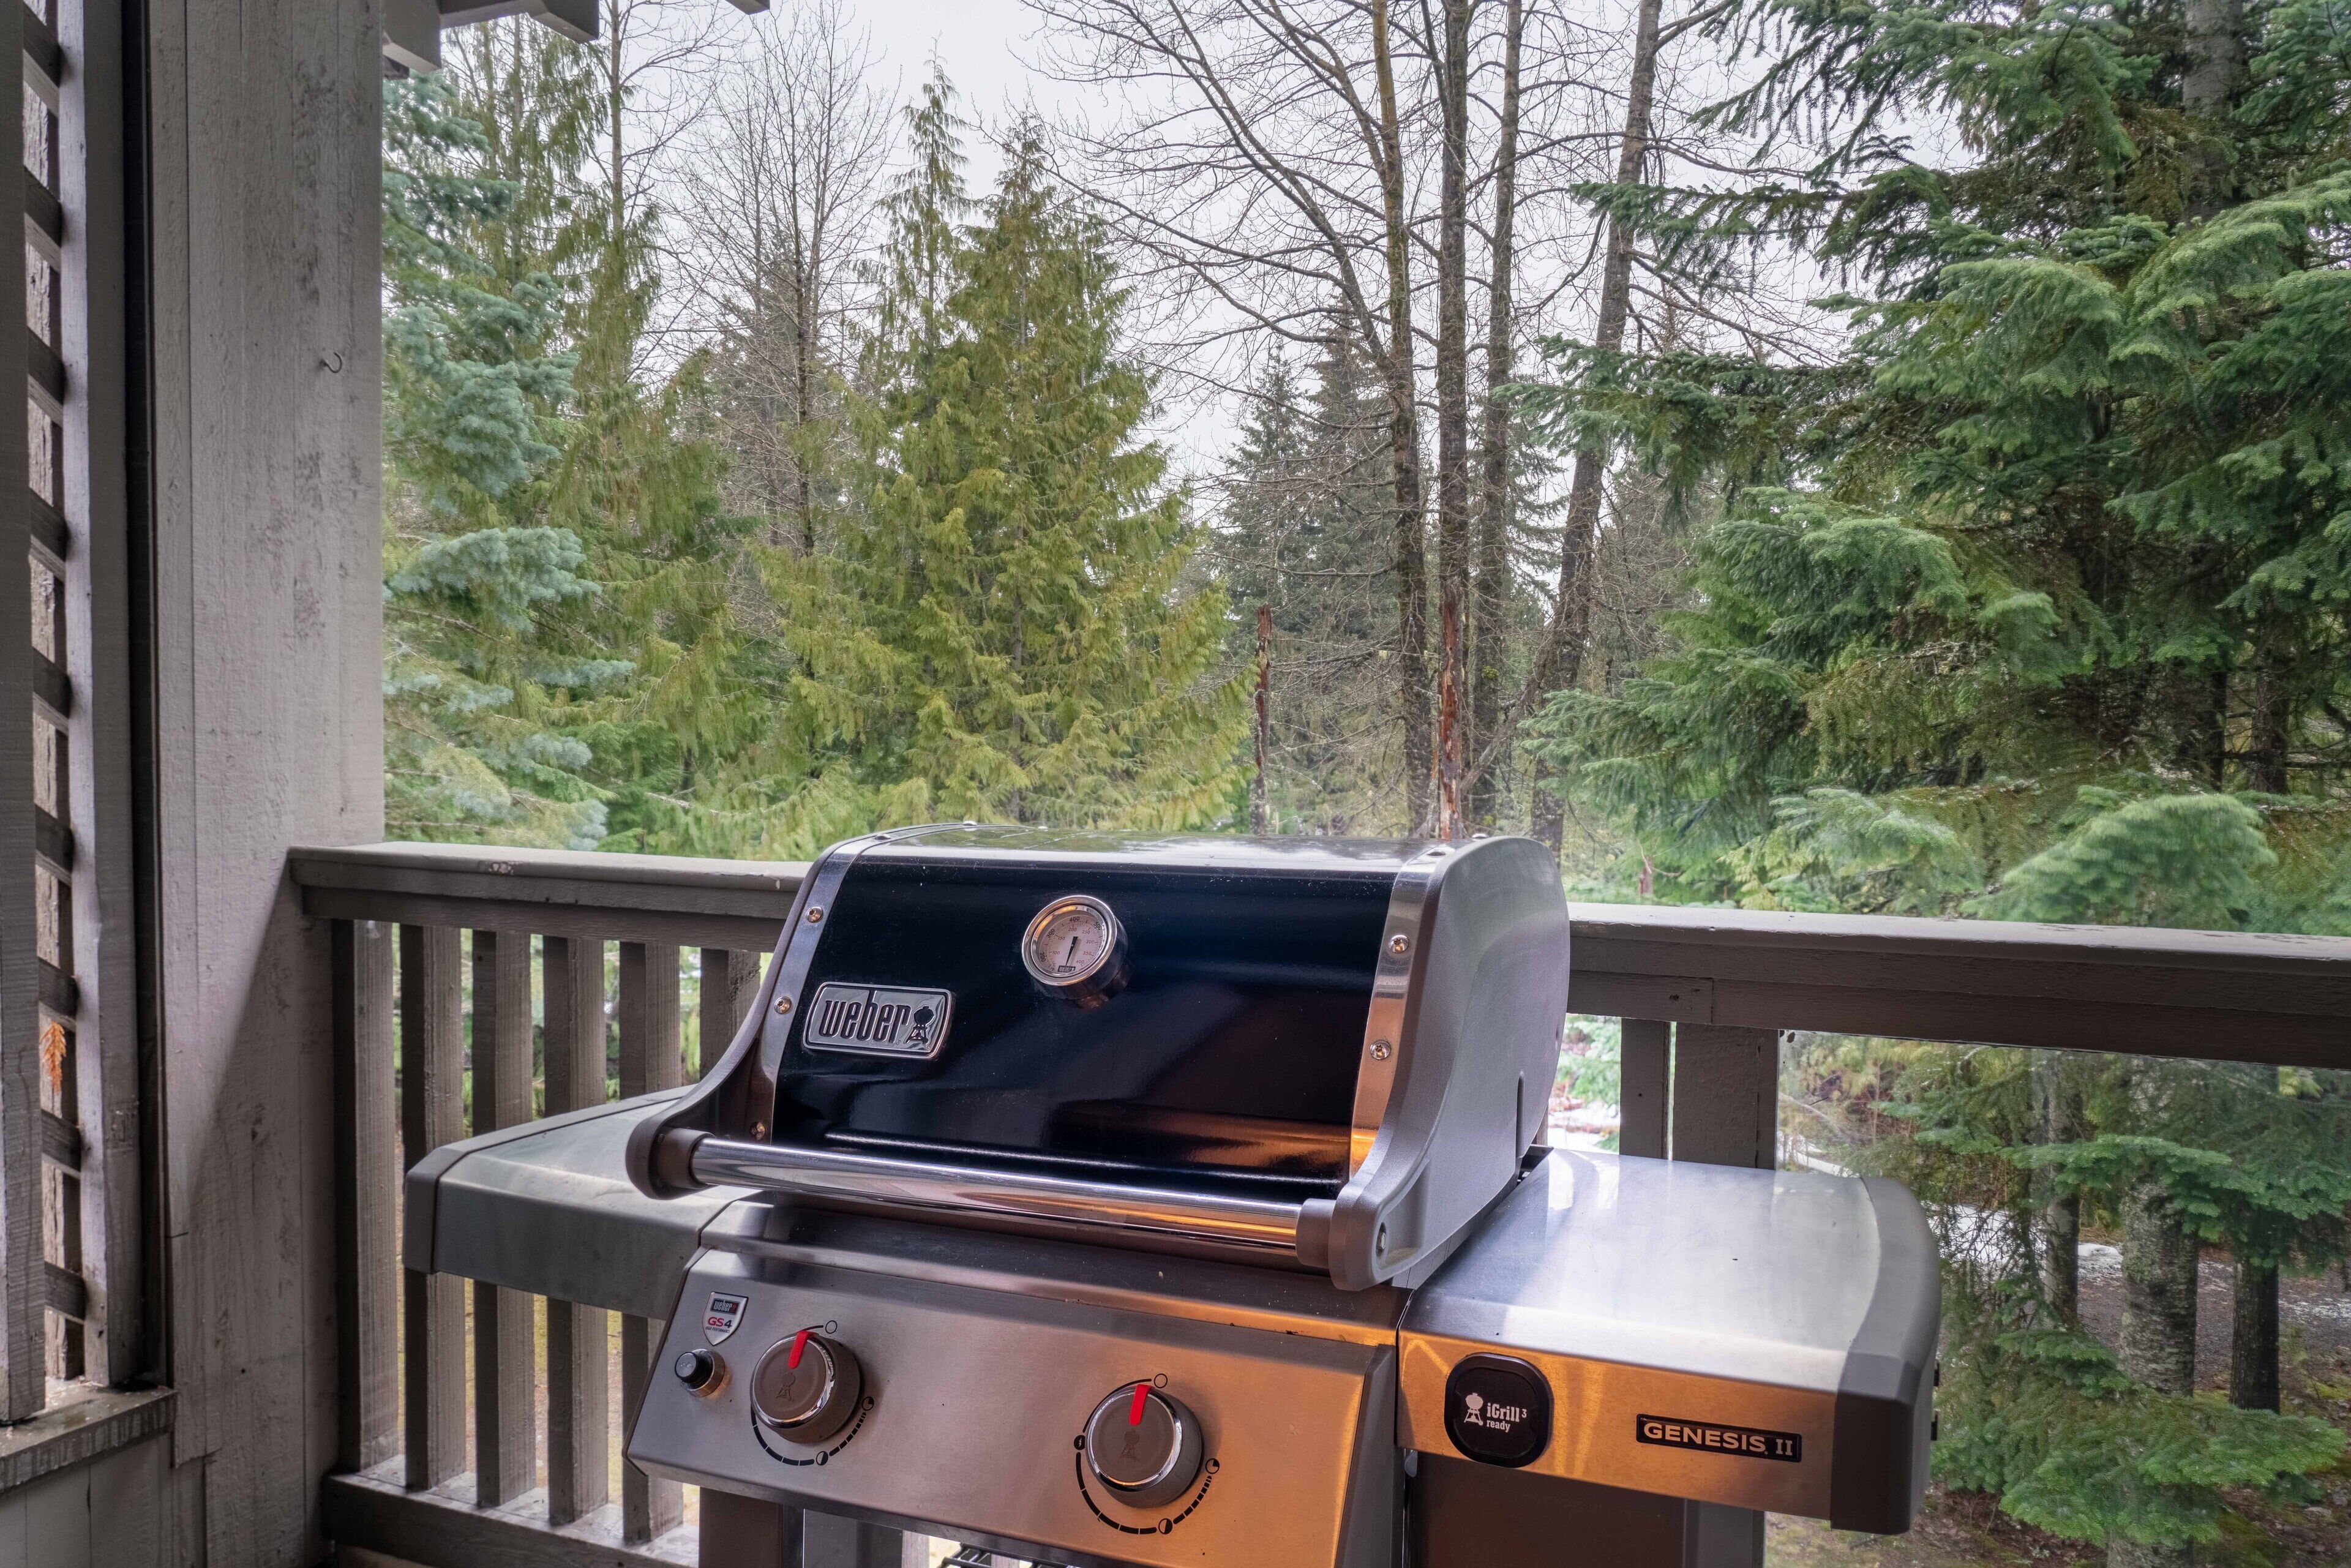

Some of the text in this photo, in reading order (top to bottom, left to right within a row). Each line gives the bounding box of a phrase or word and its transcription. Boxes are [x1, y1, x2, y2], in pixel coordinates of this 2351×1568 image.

[1093, 921, 1102, 930] 500
[1046, 929, 1055, 938] 300
[819, 989, 912, 1043] weber
[713, 1300, 733, 1311] weber
[708, 1316, 732, 1329] GS4
[1487, 1419, 1510, 1433] ready
[1643, 1422, 1793, 1456] GENESIS II
